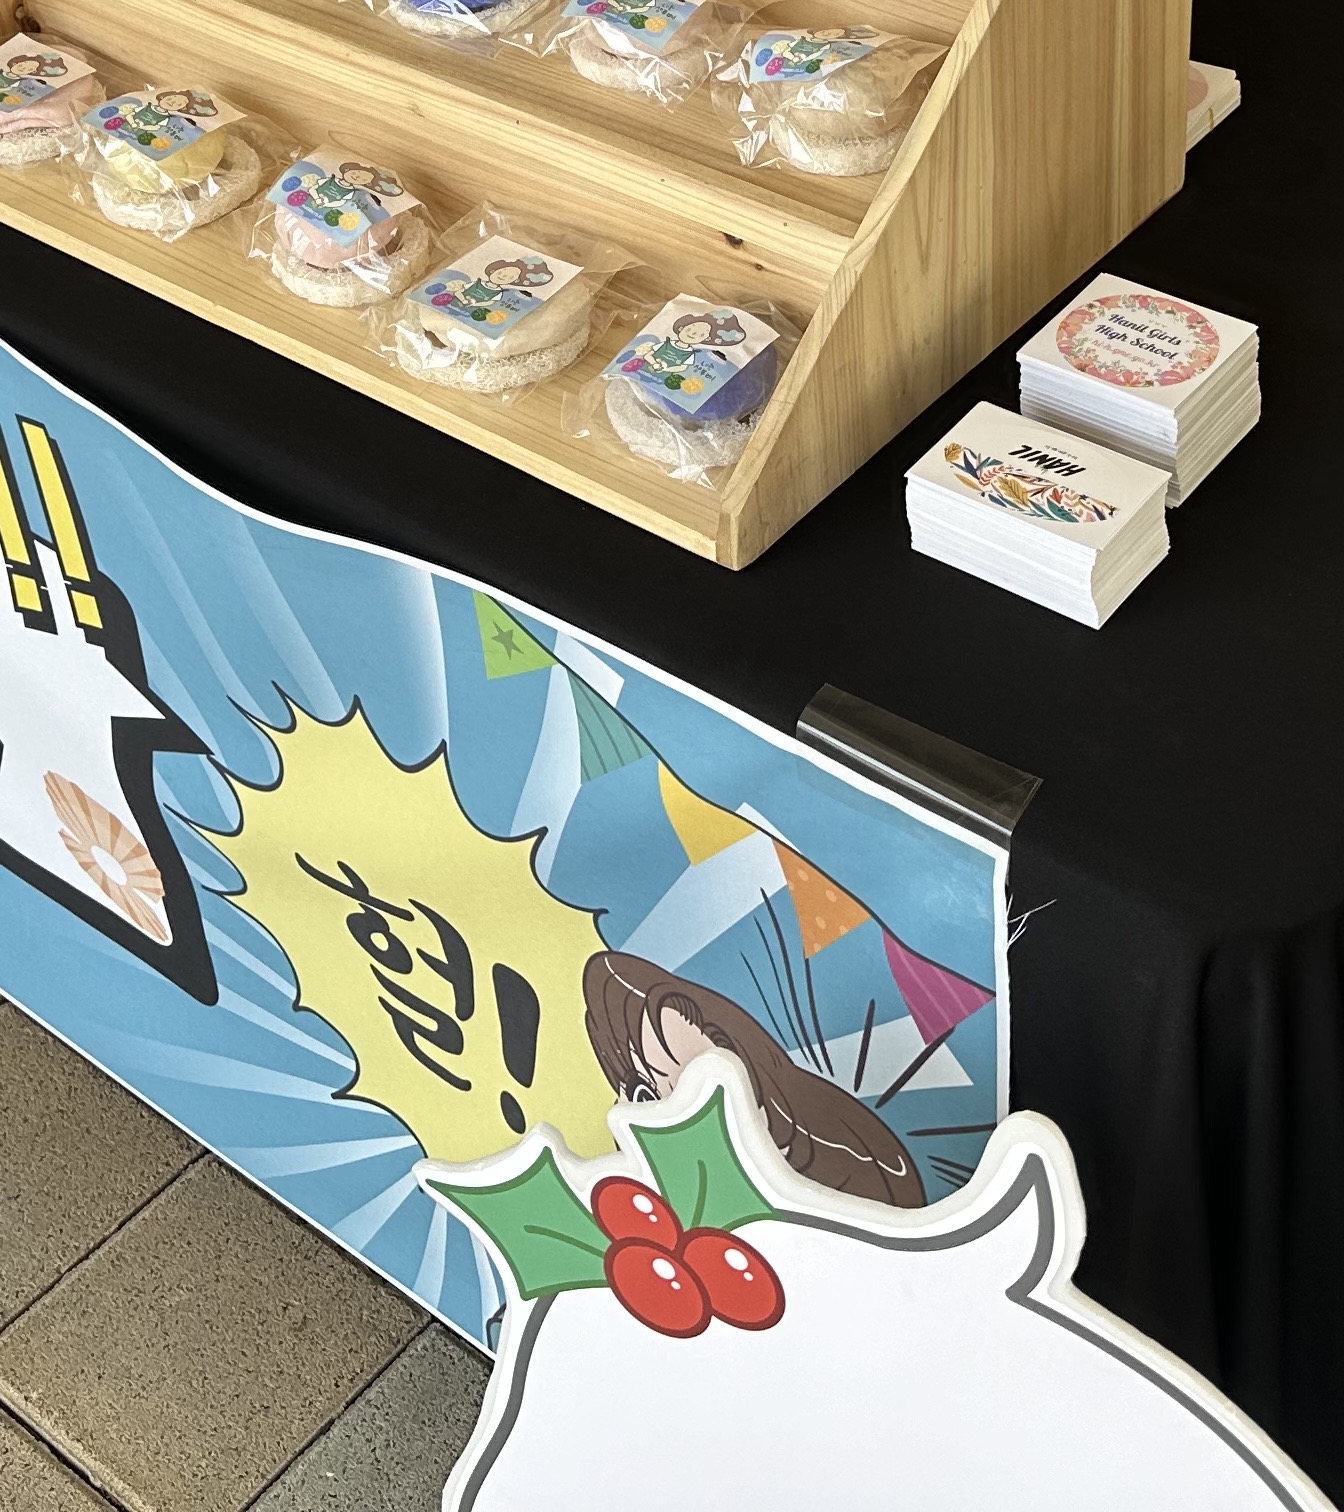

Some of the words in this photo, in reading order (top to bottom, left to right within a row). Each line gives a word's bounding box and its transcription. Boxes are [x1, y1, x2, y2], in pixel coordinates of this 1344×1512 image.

[1095, 324, 1128, 342] High
[1130, 337, 1179, 360] School
[1108, 313, 1149, 333] Hanil
[1147, 328, 1182, 346] Girls
[1008, 444, 1087, 477] HANIL
